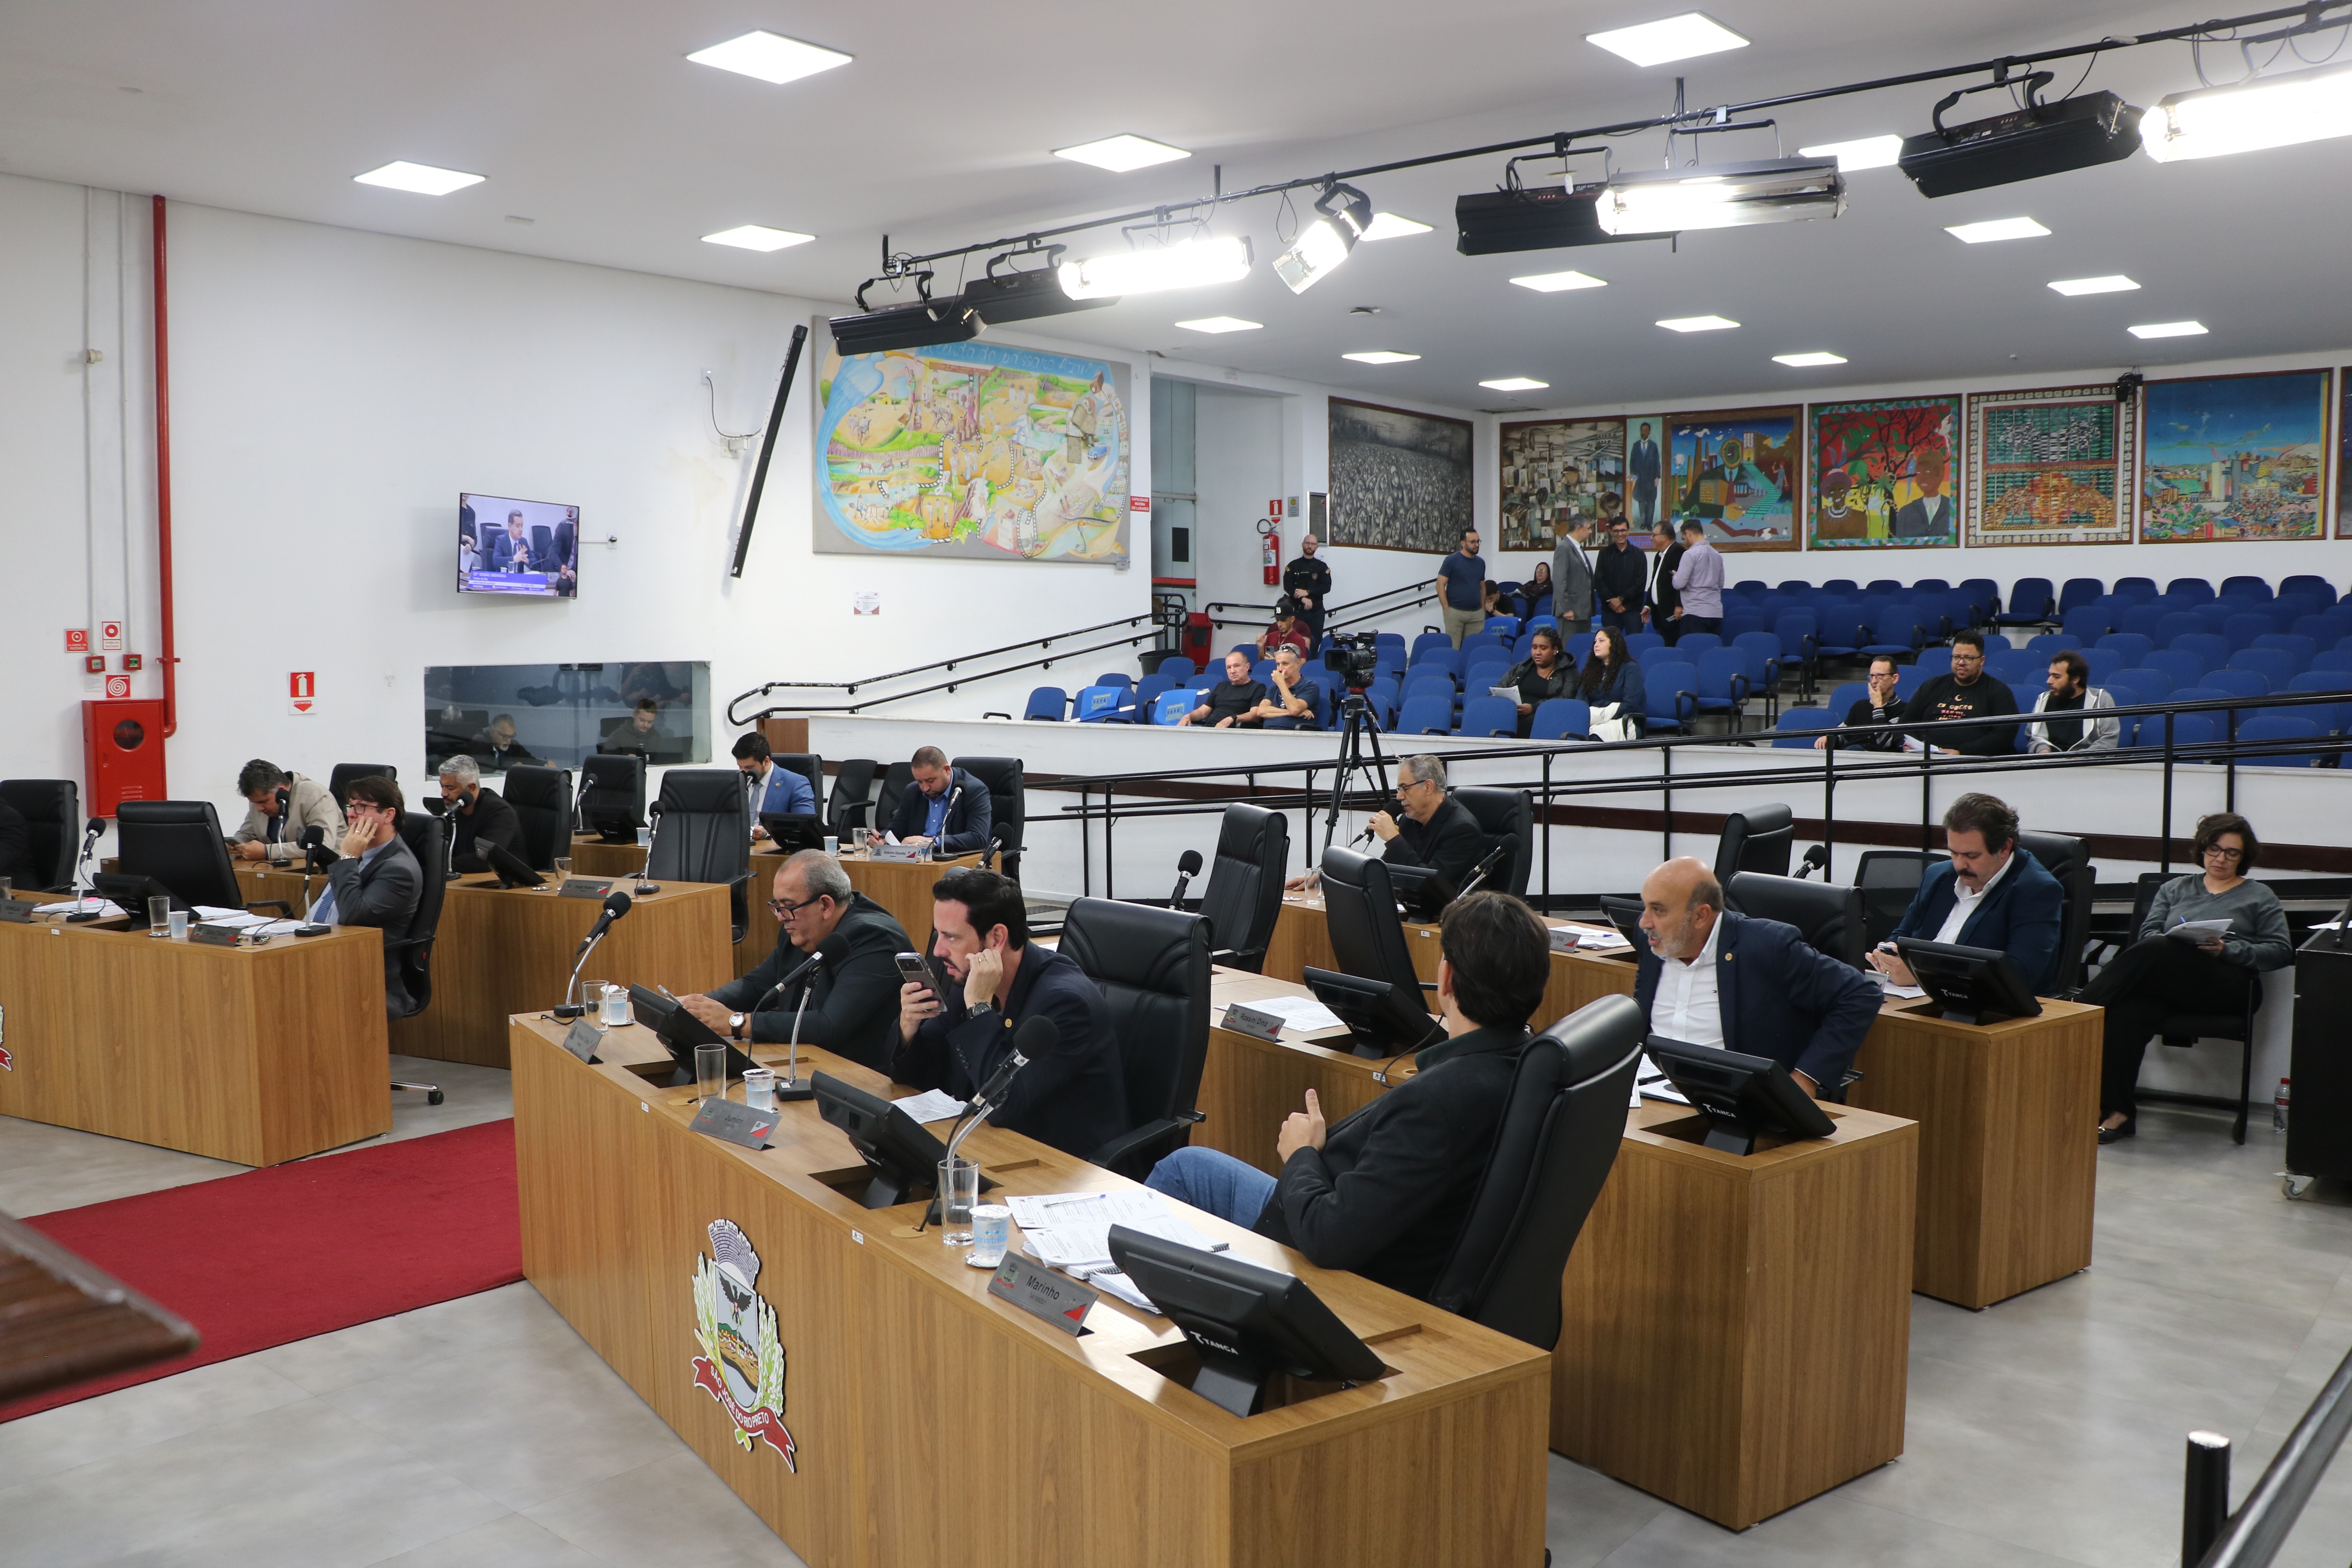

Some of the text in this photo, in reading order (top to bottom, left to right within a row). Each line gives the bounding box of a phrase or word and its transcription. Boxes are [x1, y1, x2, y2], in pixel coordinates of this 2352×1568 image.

[1240, 1013, 1256, 1024] Rossini
[1257, 1018, 1268, 1027] Diniz
[724, 1114, 744, 1125] Junior
[1711, 1108, 1736, 1118] TANCA
[1025, 1275, 1060, 1300] Marinho
[1203, 1338, 1239, 1355] TANCA
[710, 1365, 769, 1428] SÃO JOSÉ DO RIO PRETO
